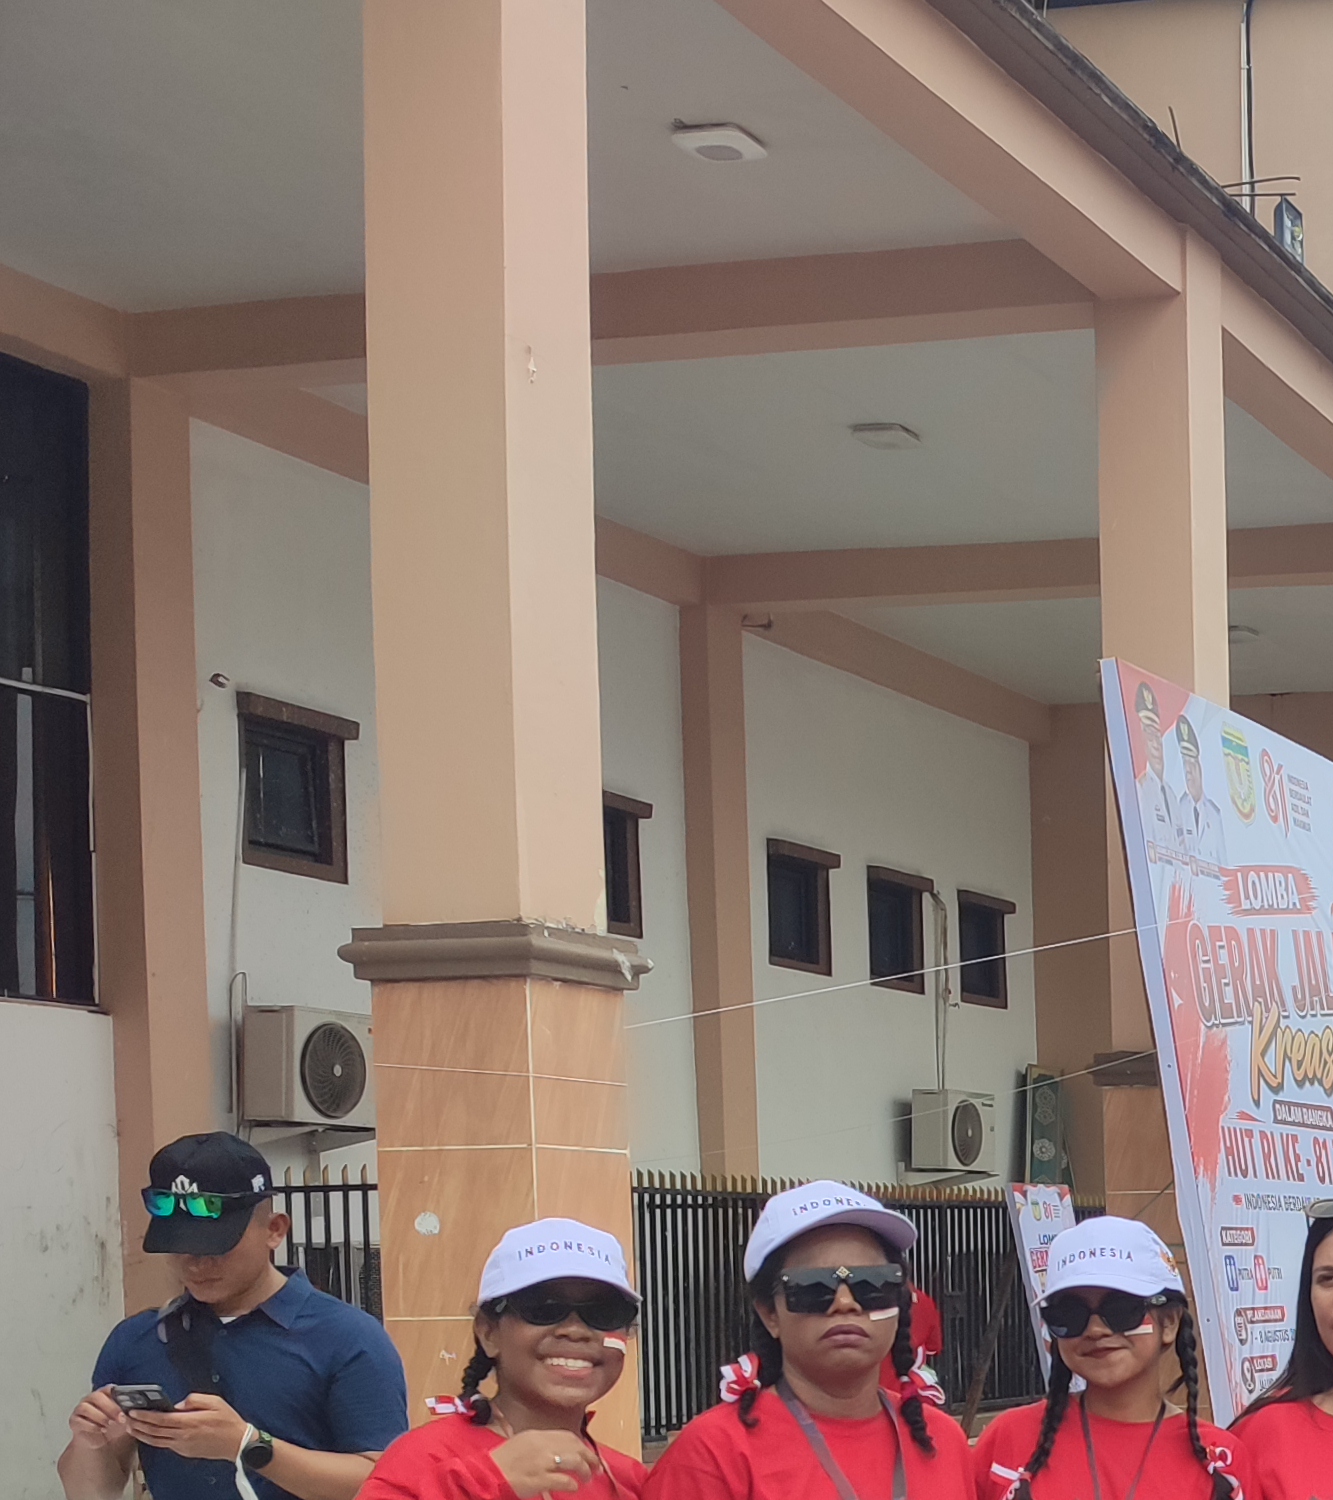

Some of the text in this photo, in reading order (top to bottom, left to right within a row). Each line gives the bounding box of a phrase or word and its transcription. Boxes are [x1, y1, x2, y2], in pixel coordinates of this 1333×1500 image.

[1237, 870, 1302, 911] LOMBA
[1187, 921, 1290, 1027] GERAK
[1221, 1126, 1258, 1180] HUT
[1258, 1131, 1278, 1182] RI
[1279, 1133, 1305, 1183] KE
[1313, 1137, 1333, 1186] 81
[517, 1240, 612, 1266] INDONESIA
[1057, 1247, 1134, 1272] INDONESIA
